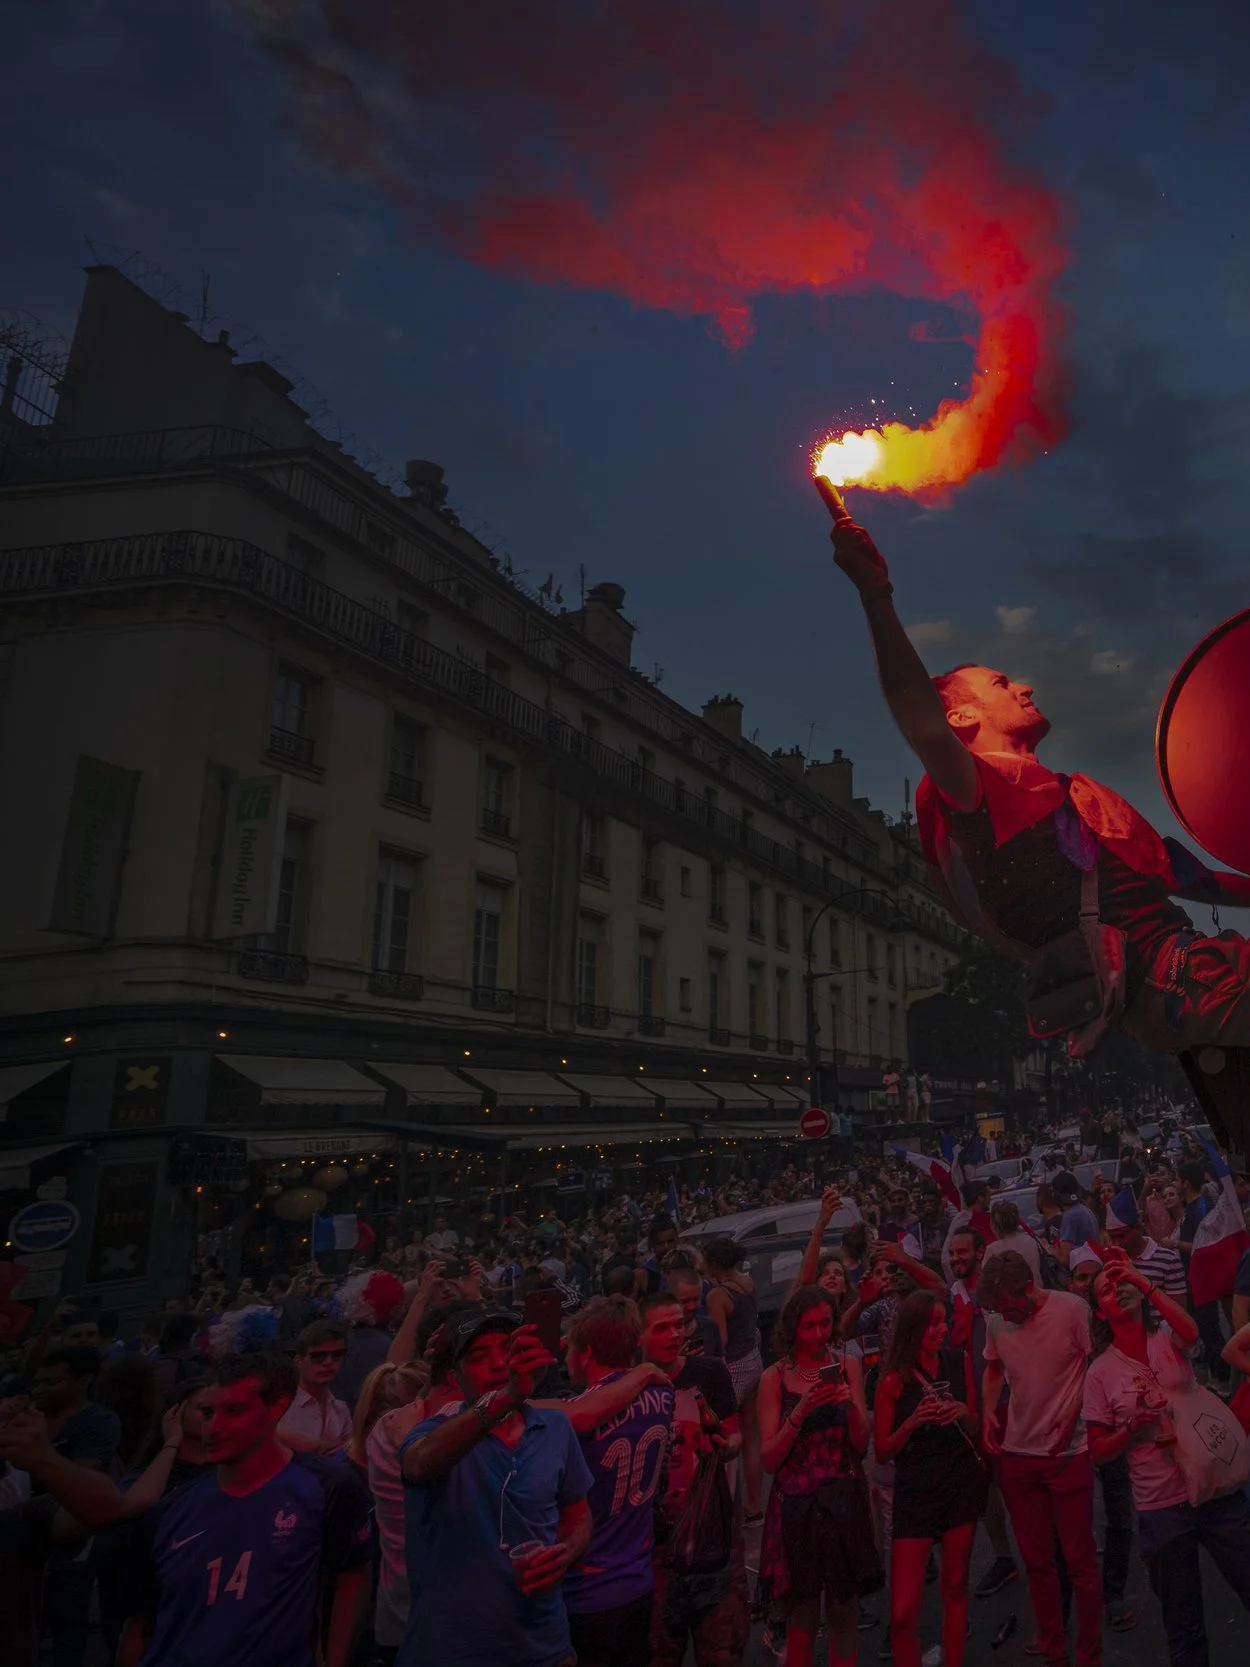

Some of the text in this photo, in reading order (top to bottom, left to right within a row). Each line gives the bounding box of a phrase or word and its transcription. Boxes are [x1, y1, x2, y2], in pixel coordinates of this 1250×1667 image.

[230, 827, 260, 926] Holiday Inn
[600, 1424, 668, 1516] 10
[206, 1550, 253, 1607] 14
